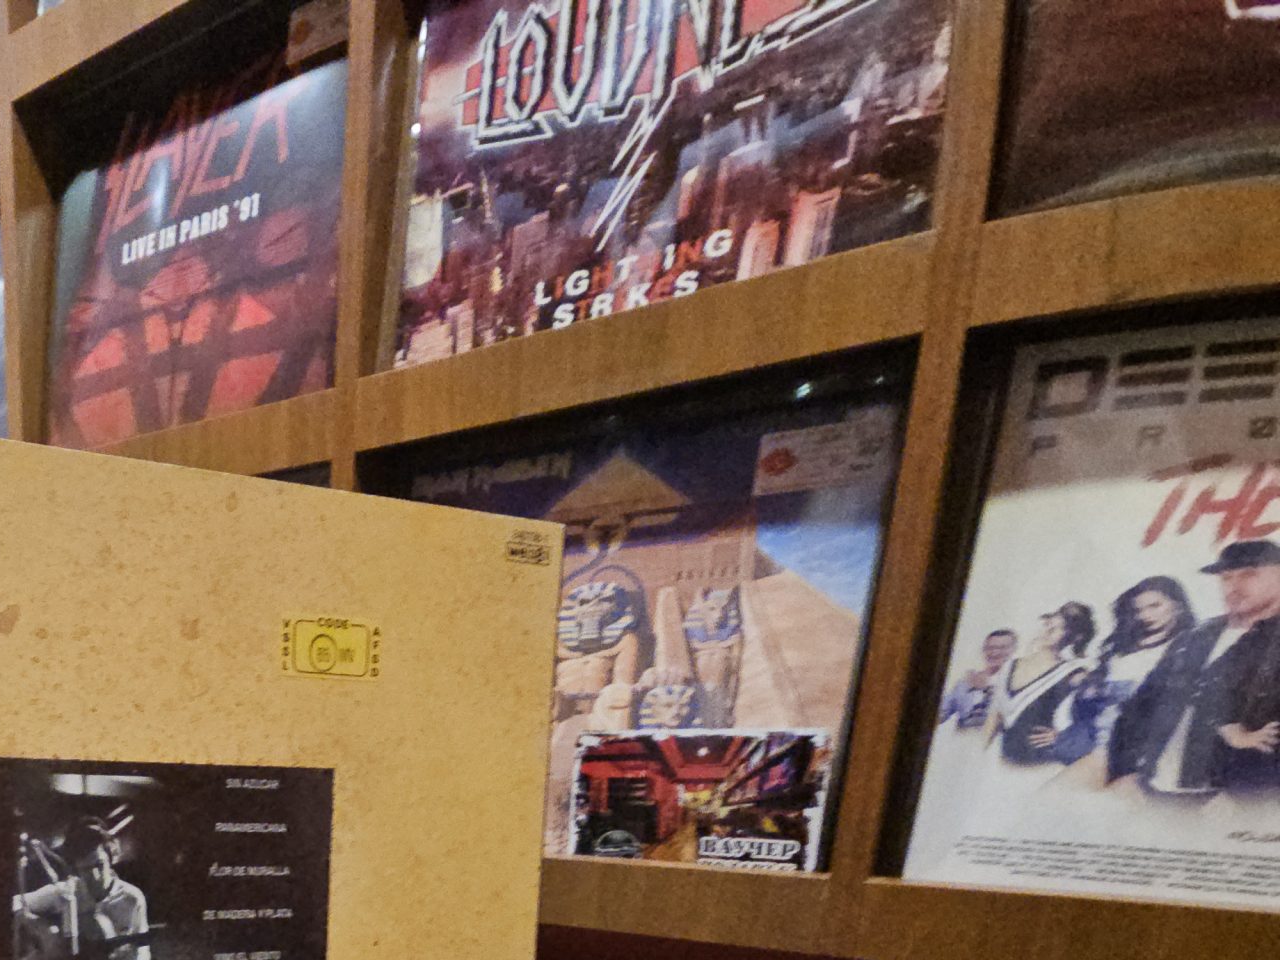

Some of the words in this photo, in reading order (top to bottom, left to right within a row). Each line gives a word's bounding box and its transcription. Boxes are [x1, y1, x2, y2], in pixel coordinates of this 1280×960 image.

[121, 231, 157, 265] LIVE
[158, 224, 177, 253] IN
[179, 204, 229, 243] PARIS
[233, 192, 261, 221] '91
[700, 837, 800, 859] ВАУЧЕР
